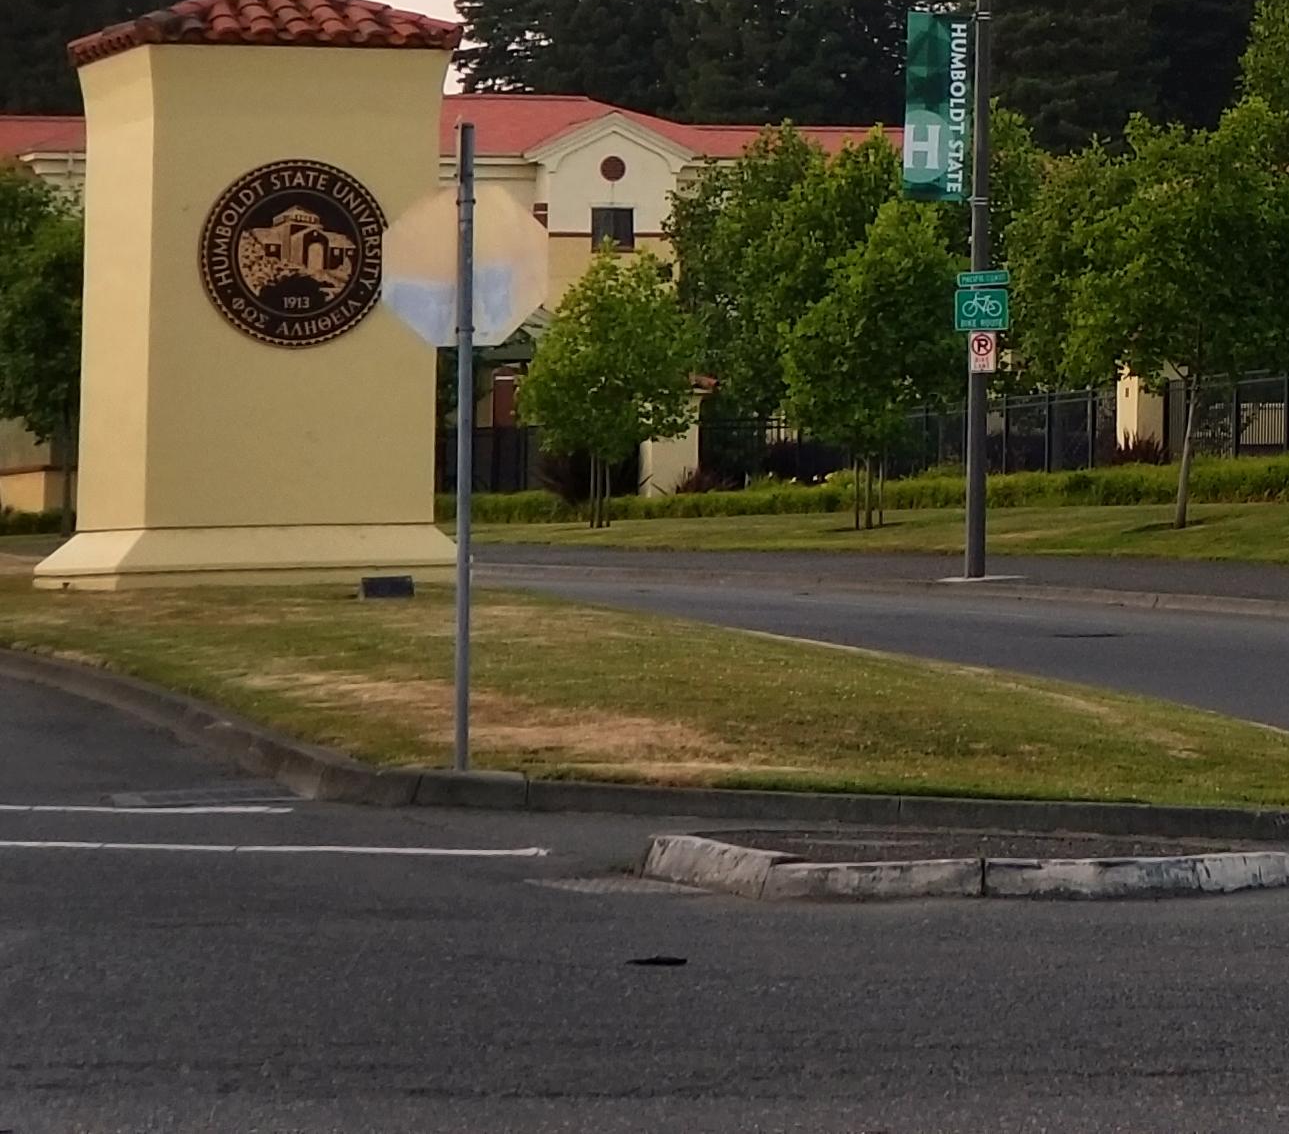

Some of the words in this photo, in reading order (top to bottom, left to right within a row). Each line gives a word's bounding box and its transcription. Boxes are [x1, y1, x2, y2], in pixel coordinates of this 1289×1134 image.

[948, 23, 967, 133] HUMBOLDT
[904, 124, 941, 169] H
[946, 141, 964, 194] STATE
[212, 179, 265, 286] HUMBOLDT
[270, 171, 328, 191] STATE
[332, 182, 380, 291] UNIVERSITY
[283, 297, 310, 309] 1913
